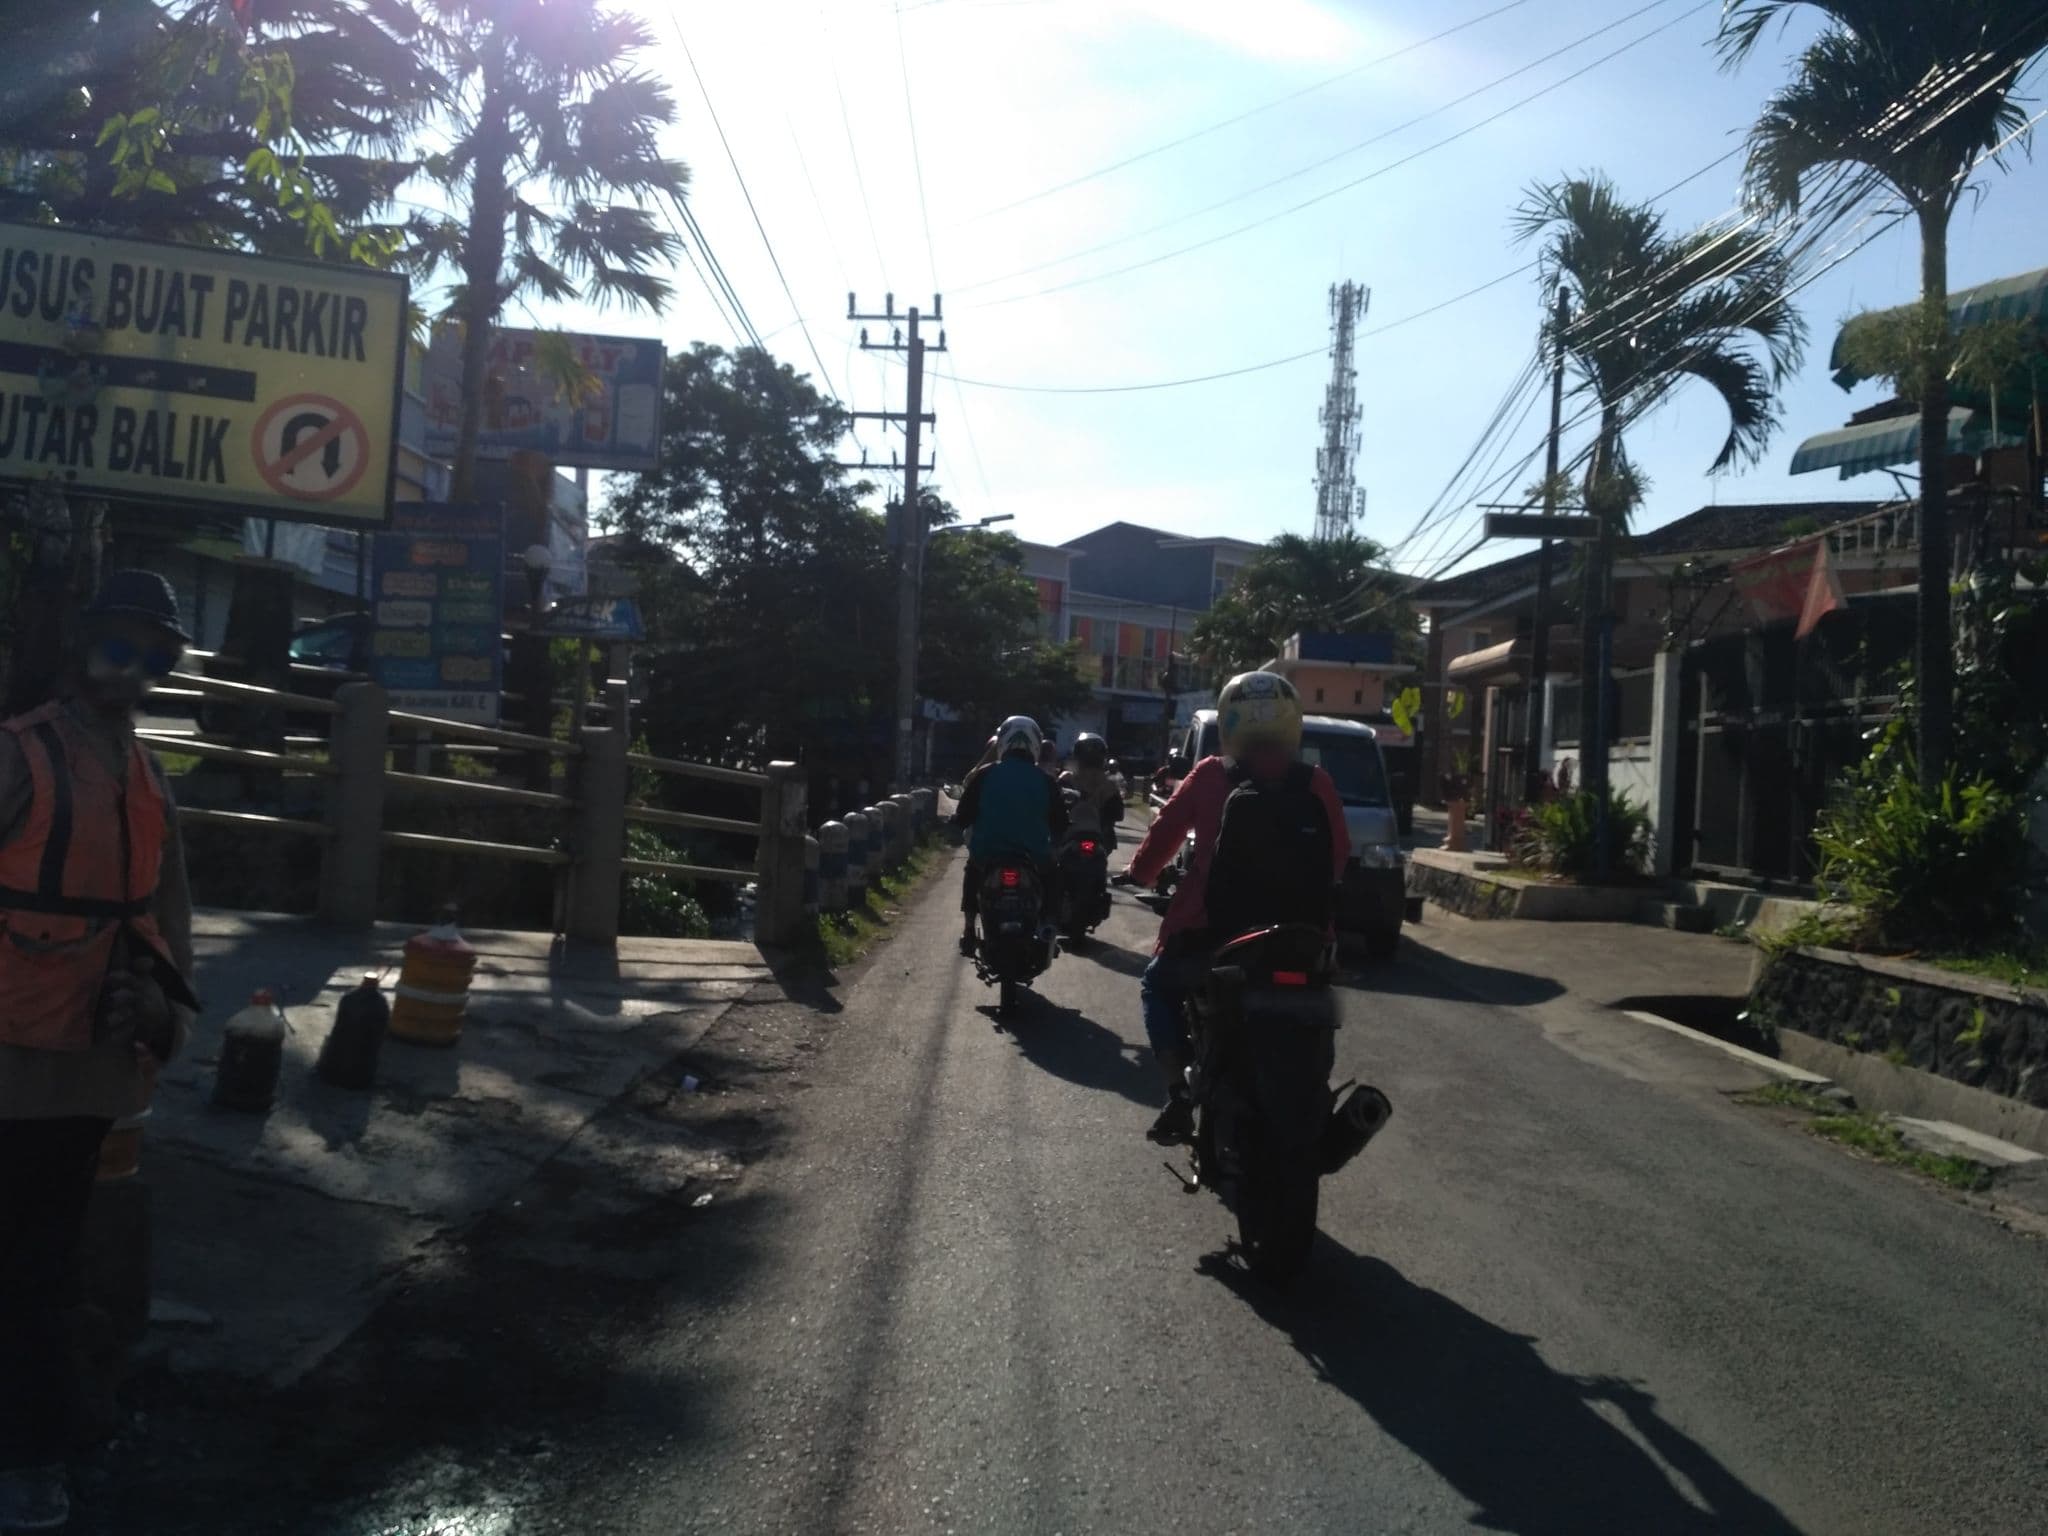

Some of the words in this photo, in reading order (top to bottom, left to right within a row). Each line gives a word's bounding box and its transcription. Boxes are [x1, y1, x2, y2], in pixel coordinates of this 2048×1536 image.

[106, 263, 215, 340] BUAT
[223, 279, 368, 363] PARKIR
[108, 406, 231, 484] BALIK
